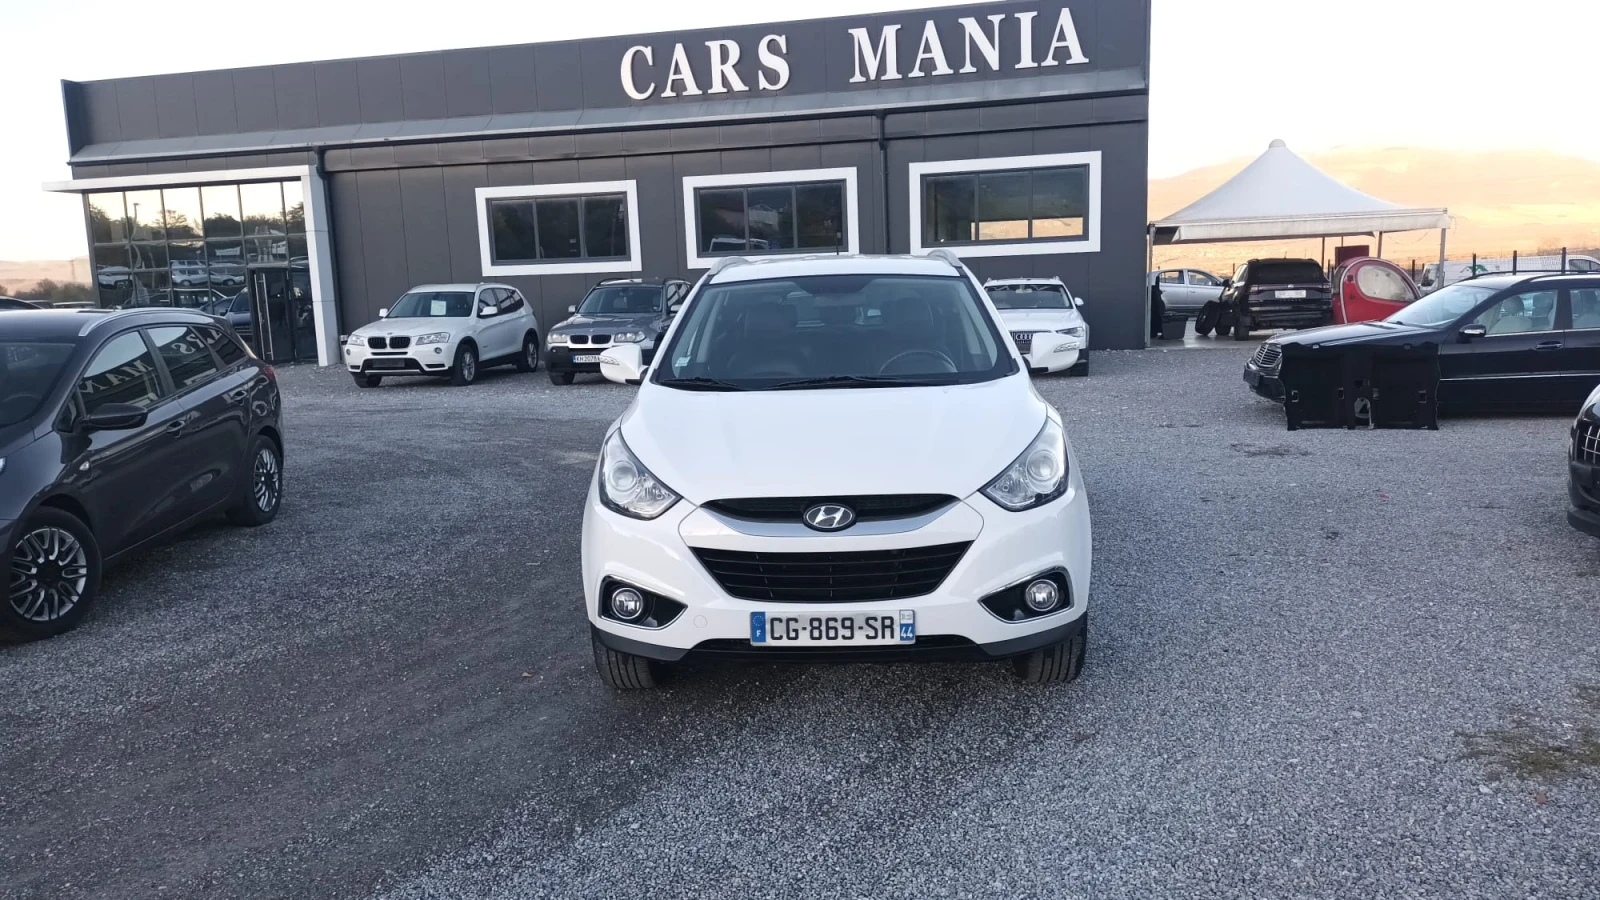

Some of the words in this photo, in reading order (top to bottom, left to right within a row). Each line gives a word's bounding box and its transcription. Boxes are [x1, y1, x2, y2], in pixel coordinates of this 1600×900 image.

[620, 34, 791, 100] CARS
[848, 7, 1090, 84] MANIA
[756, 629, 761, 638] F
[769, 616, 895, 641] CG-869-SR
[900, 626, 914, 638] 44
